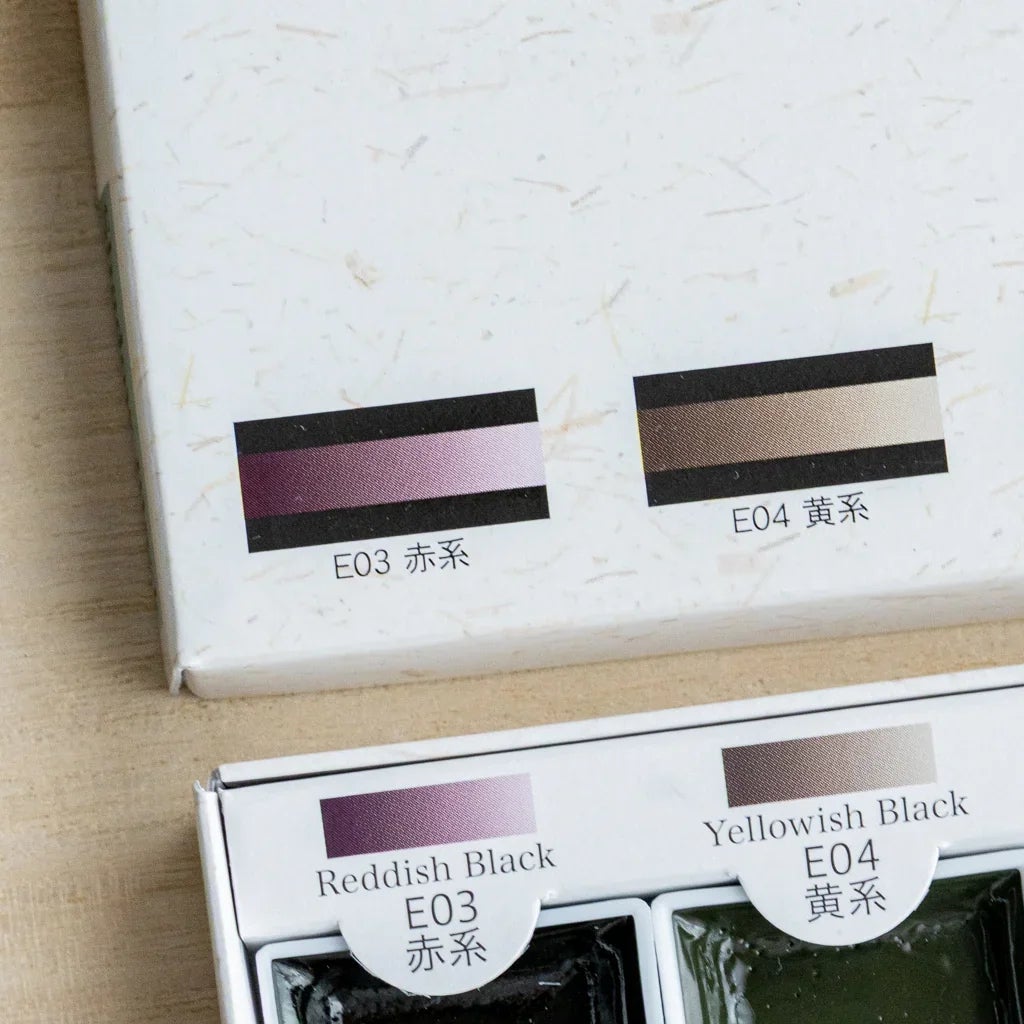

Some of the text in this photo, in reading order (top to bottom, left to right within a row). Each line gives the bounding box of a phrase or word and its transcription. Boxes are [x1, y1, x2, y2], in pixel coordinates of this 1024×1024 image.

[733, 491, 869, 533] E04 黄系
[334, 538, 469, 579] E03 赤系
[703, 790, 968, 846] Yellowish Black
[317, 843, 556, 896] Reddish Black
[805, 839, 879, 879] E04
[406, 890, 477, 930] E03
[805, 876, 886, 922] 黄系
[406, 927, 487, 973] 赤系
